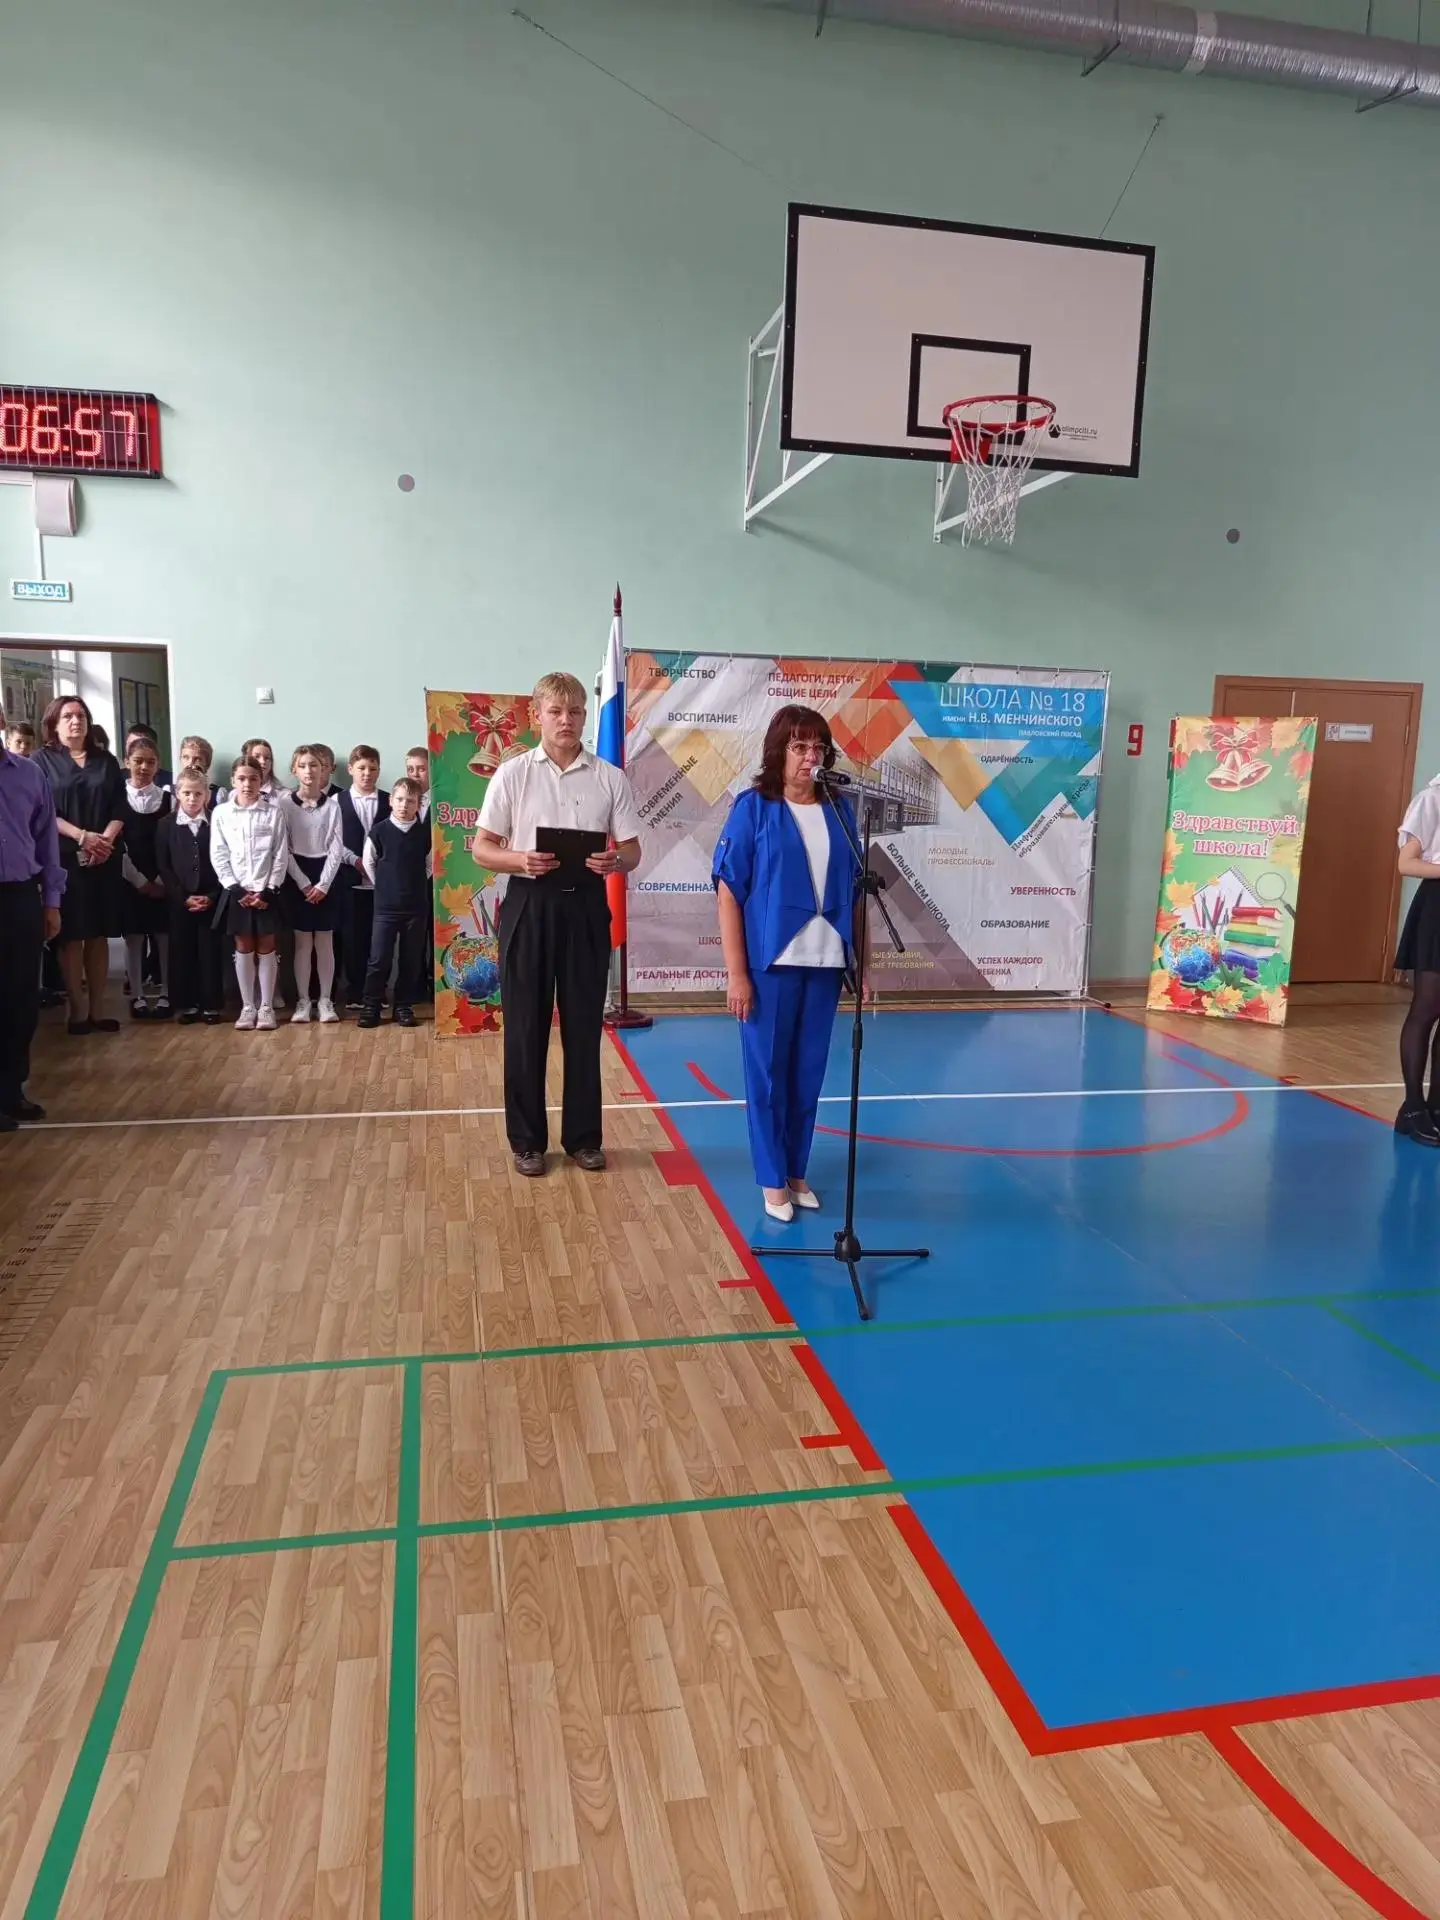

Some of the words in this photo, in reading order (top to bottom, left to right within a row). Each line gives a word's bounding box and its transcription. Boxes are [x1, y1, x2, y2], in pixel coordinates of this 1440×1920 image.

[17, 583, 64, 597] ВЫХОД
[648, 667, 716, 679] ТВОРЧЕСТВО
[827, 674, 854, 685] ДЕТИ
[767, 687, 806, 699] ОБЩИЕ
[809, 689, 837, 700] ЦЕЛИ
[939, 686, 1022, 710] ШКОЛА
[1061, 691, 1086, 713] 18
[667, 711, 738, 724] ВОСПИТАНИЕ
[968, 712, 991, 724] Н.В.
[994, 715, 1082, 727] МЕНЧИНСКОГО
[1127, 724, 1144, 756] 9
[637, 755, 698, 818] СОВРЕМЕННЫЕ
[647, 792, 683, 829] УМЕНИЯ
[928, 847, 969, 855] МОЛОДЫЕ
[927, 858, 995, 866] ПРОФЕССИОНАЛЫ
[638, 882, 716, 892] СОВРЕМЕННАЯ
[886, 842, 916, 881] БОЛЬШЕ
[913, 879, 929, 900] ЧЕМ
[925, 898, 951, 932] ШКОЛА
[1010, 886, 1077, 896] УВЕРЕННОСТЬ
[980, 919, 1050, 928] ОБРАЗОВАНИЕ
[698, 936, 722, 946] ШКО
[977, 956, 1001, 965] УСПЕХ
[1003, 957, 1044, 965] КАЖДОГО
[636, 970, 691, 979] РЕАЛЬНЫЕ
[693, 970, 729, 980] ДОСТИ
